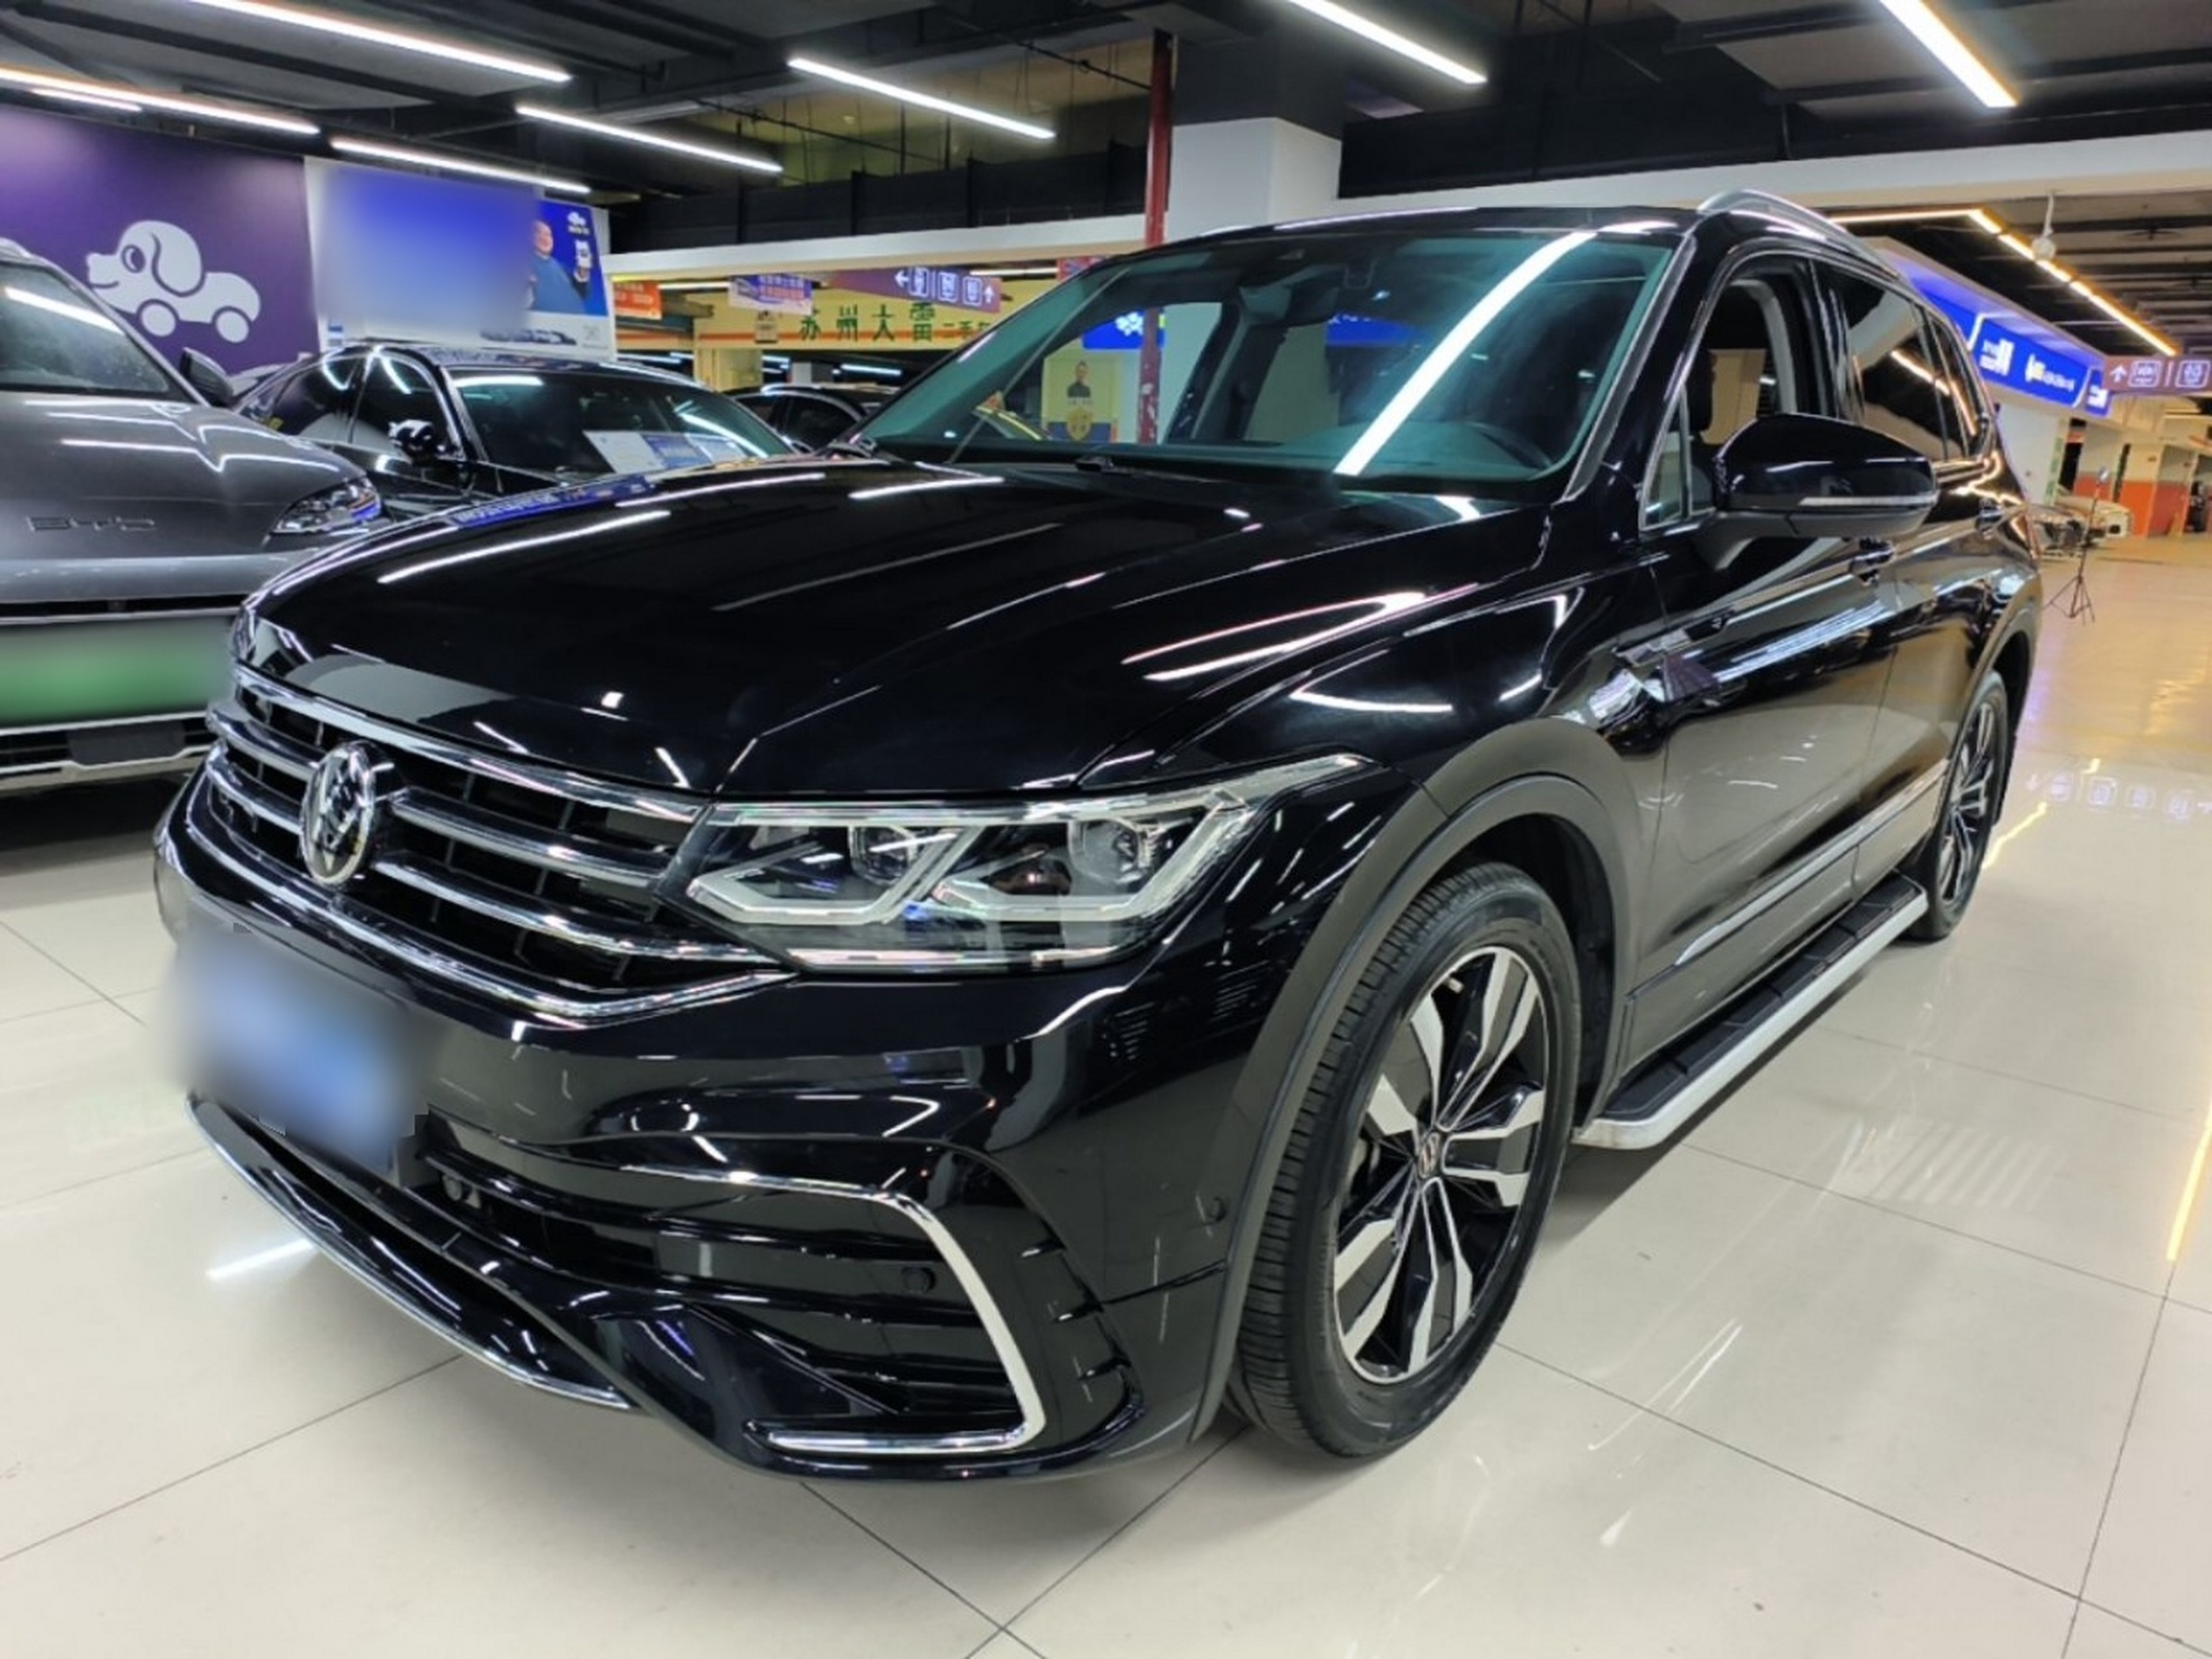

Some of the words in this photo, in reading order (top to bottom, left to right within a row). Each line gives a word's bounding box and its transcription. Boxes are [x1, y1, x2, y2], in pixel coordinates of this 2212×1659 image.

[799, 301, 935, 342] 苏州大雷
[26, 516, 157, 532] BYD
